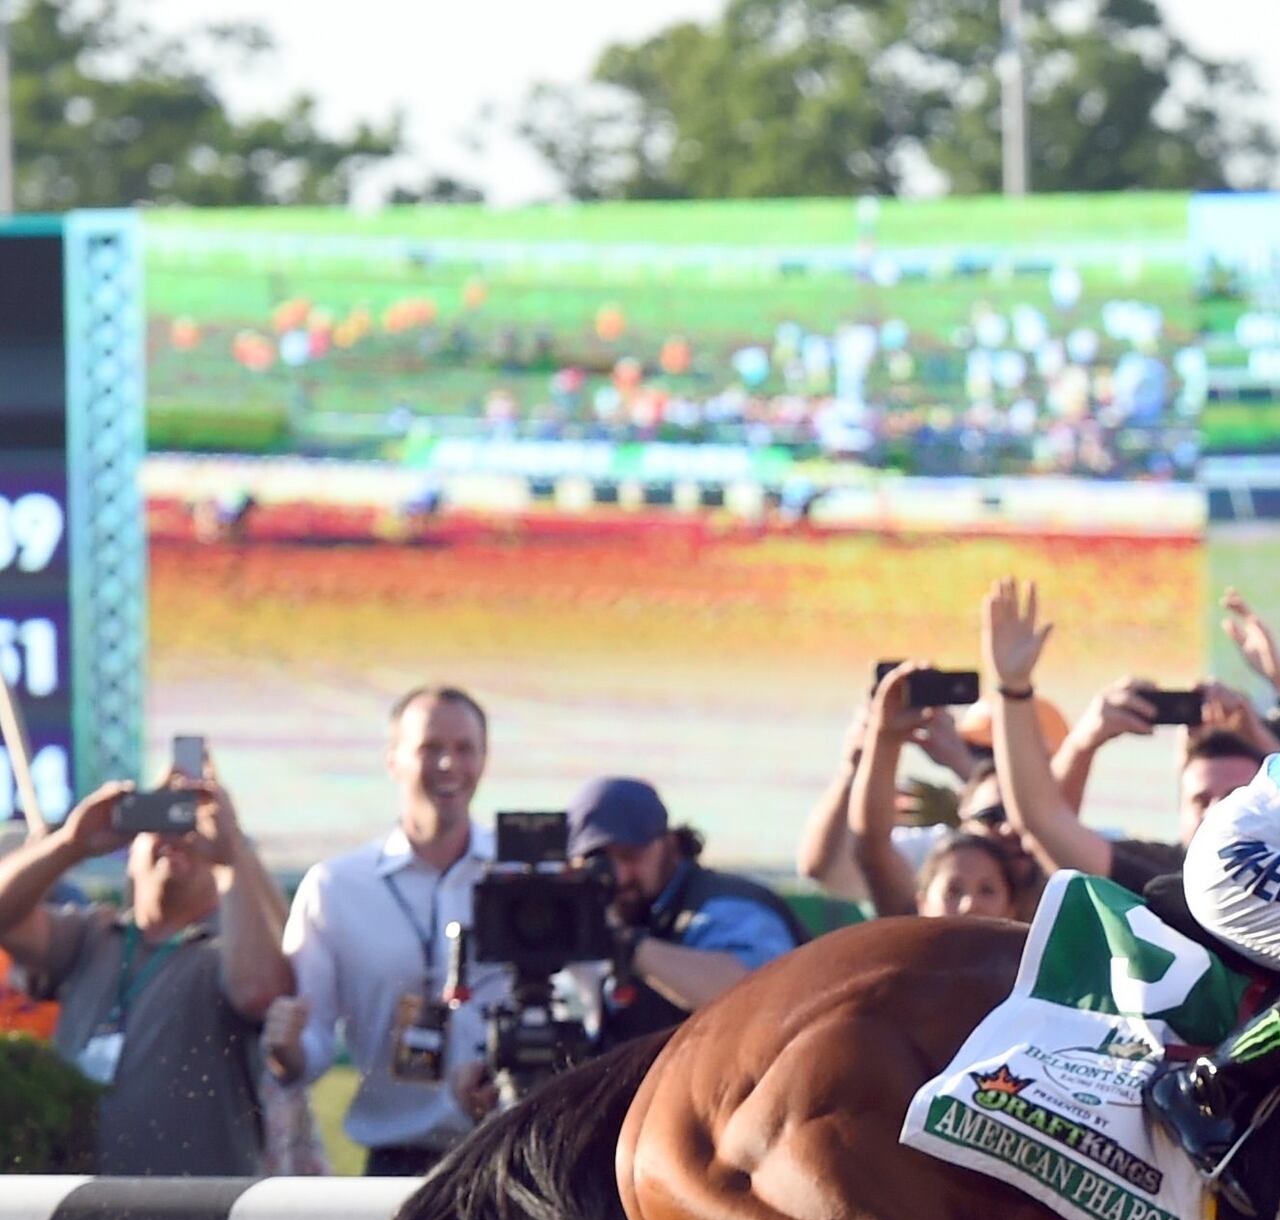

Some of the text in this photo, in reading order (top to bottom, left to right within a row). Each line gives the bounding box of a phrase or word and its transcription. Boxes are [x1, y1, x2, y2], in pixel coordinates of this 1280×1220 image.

[934, 1100, 1075, 1190] AMERICAN
[974, 1088, 1163, 1194] DRAFTKINGS
[1033, 1088, 1091, 1119] PRESENTED
[1094, 1115, 1109, 1128] BY
